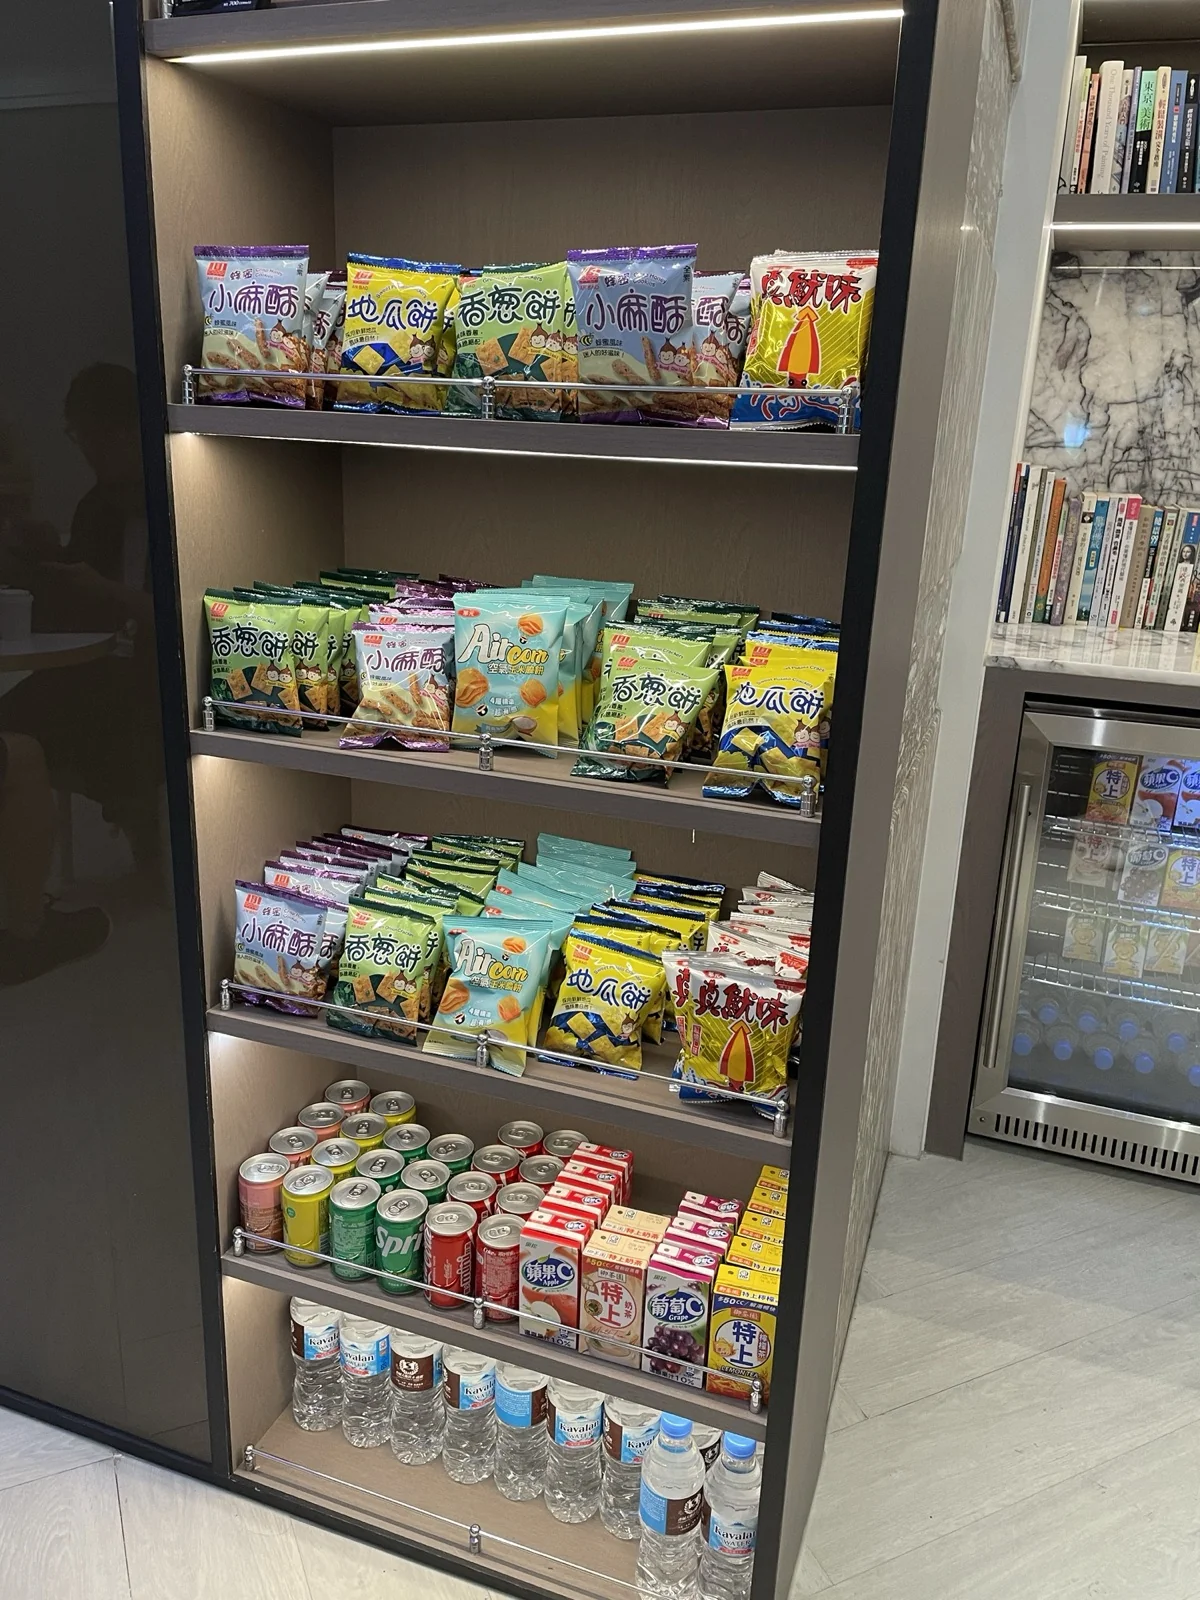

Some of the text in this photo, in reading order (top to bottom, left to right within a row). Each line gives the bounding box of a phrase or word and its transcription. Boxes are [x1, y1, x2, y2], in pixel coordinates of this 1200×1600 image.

[1105, 85, 1116, 121] Thousand
[1103, 120, 1111, 140] Years
[1097, 149, 1109, 179] Painting
[209, 281, 299, 318] 小麻酥
[347, 294, 438, 333] 地瓜餅
[457, 282, 561, 327] 香蔥餅
[586, 288, 687, 333] 小麻酥
[211, 621, 289, 662] 香蔥餅
[366, 648, 446, 673] 小麻酥
[612, 672, 702, 714] 香蔥餅
[735, 681, 824, 719] 地瓜餅
[1103, 769, 1121, 799] 特上
[1179, 857, 1197, 886] 特上
[241, 918, 317, 958] 小麻酥
[345, 932, 422, 973] 香蔥餅
[566, 968, 652, 1010] 地瓜餅
[696, 979, 790, 1034] 真魷味
[625, 1227, 660, 1240] 特上奶茶
[526, 1262, 574, 1283] 蘋果C
[608, 1254, 643, 1266] 特上奶茶
[542, 1279, 559, 1287] Apple
[600, 1281, 624, 1327] 特上
[624, 1301, 633, 1319] 奶茶
[651, 1297, 704, 1319] 葡萄C
[730, 1321, 757, 1367] 特上
[721, 1365, 746, 1376] LEMON
[723, 1539, 751, 1547] WATER
